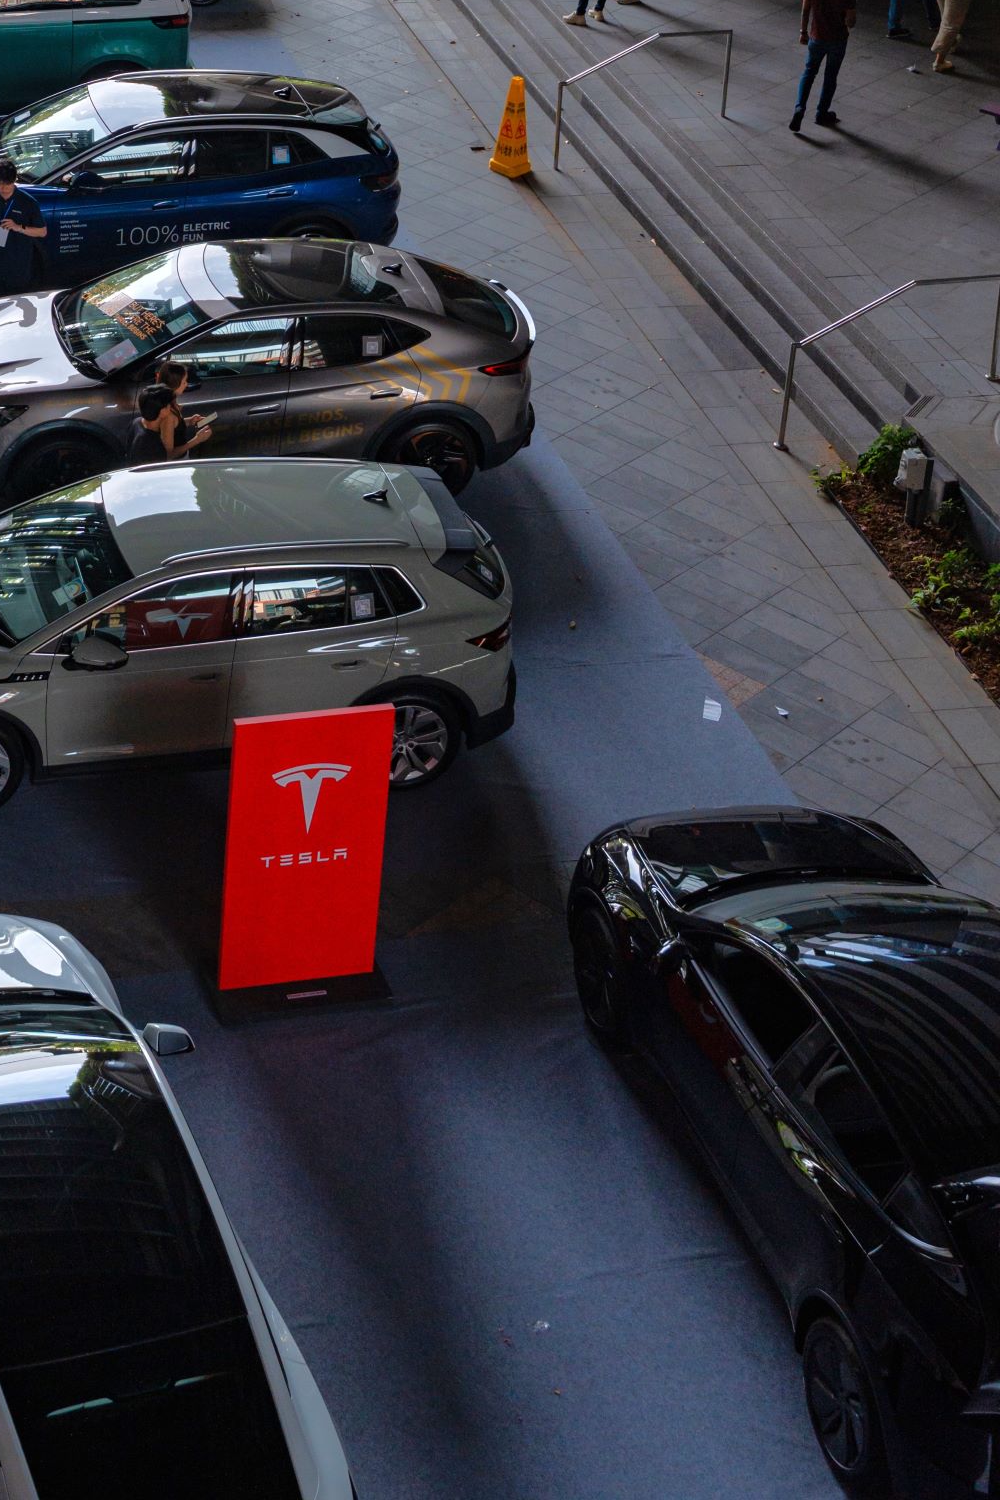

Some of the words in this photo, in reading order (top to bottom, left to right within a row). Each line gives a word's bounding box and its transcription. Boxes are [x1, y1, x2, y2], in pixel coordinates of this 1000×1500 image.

[115, 225, 179, 247] 100%
[182, 221, 231, 232] ELECTRIC
[182, 233, 204, 243] FUN
[128, 301, 144, 313] BUT
[140, 321, 157, 335] THE
[301, 422, 365, 444] BEGINS
[260, 848, 348, 869] TESLA
